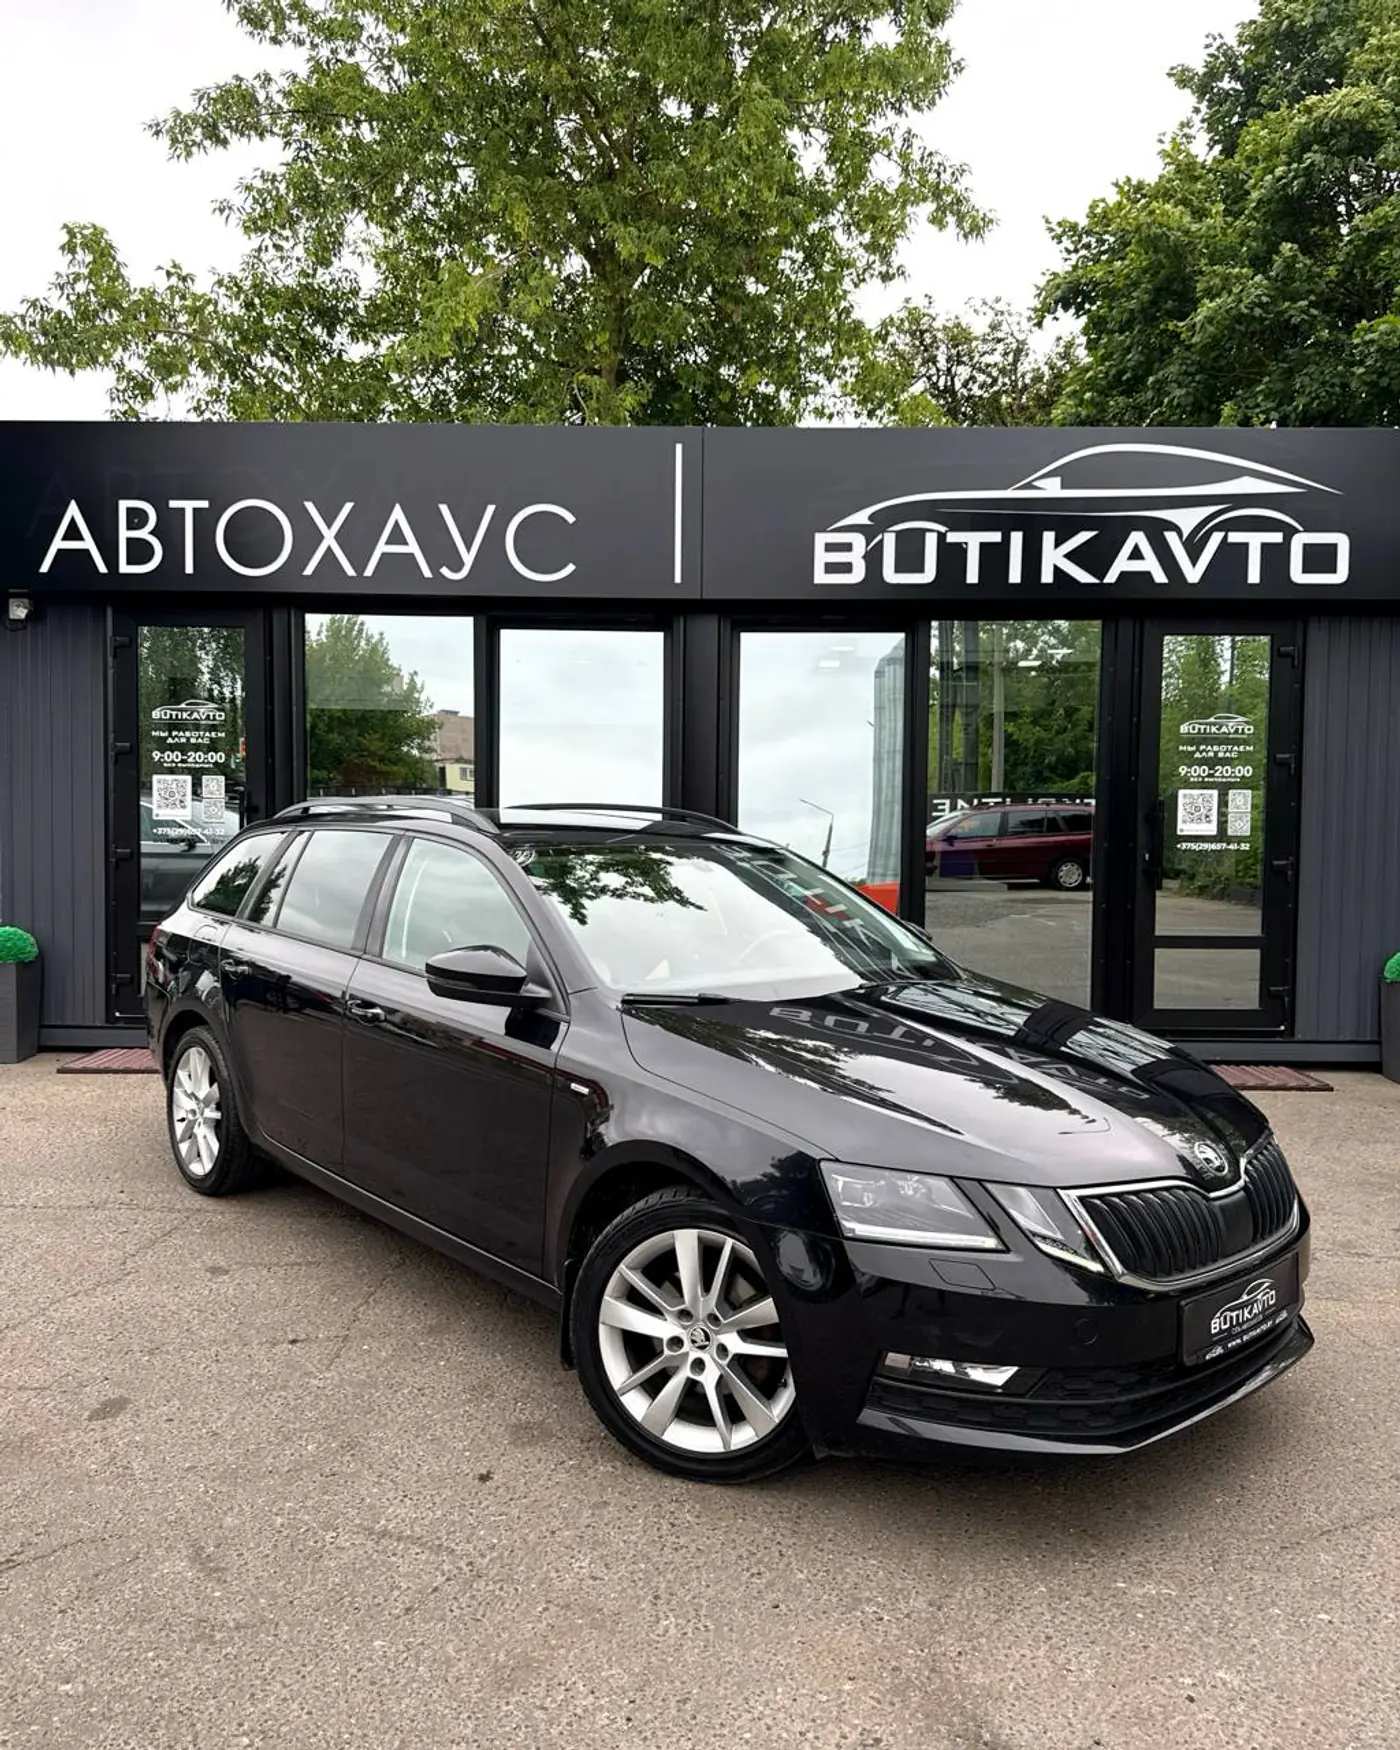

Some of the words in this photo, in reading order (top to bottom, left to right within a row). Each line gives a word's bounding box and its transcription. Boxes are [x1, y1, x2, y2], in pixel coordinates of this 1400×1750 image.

[39, 498, 578, 582] АВТОХАУС
[813, 530, 1350, 585] BUTIKAVTO
[151, 709, 226, 720] BUTIKAVTO
[172, 730, 226, 738] РАБОТАЕМ
[1180, 724, 1255, 734] BUTIKAVTO
[152, 750, 226, 763] 9:00-20:00
[1178, 765, 1253, 777] 9:00-20:00
[1210, 1289, 1276, 1334] BUTIKAVTO
